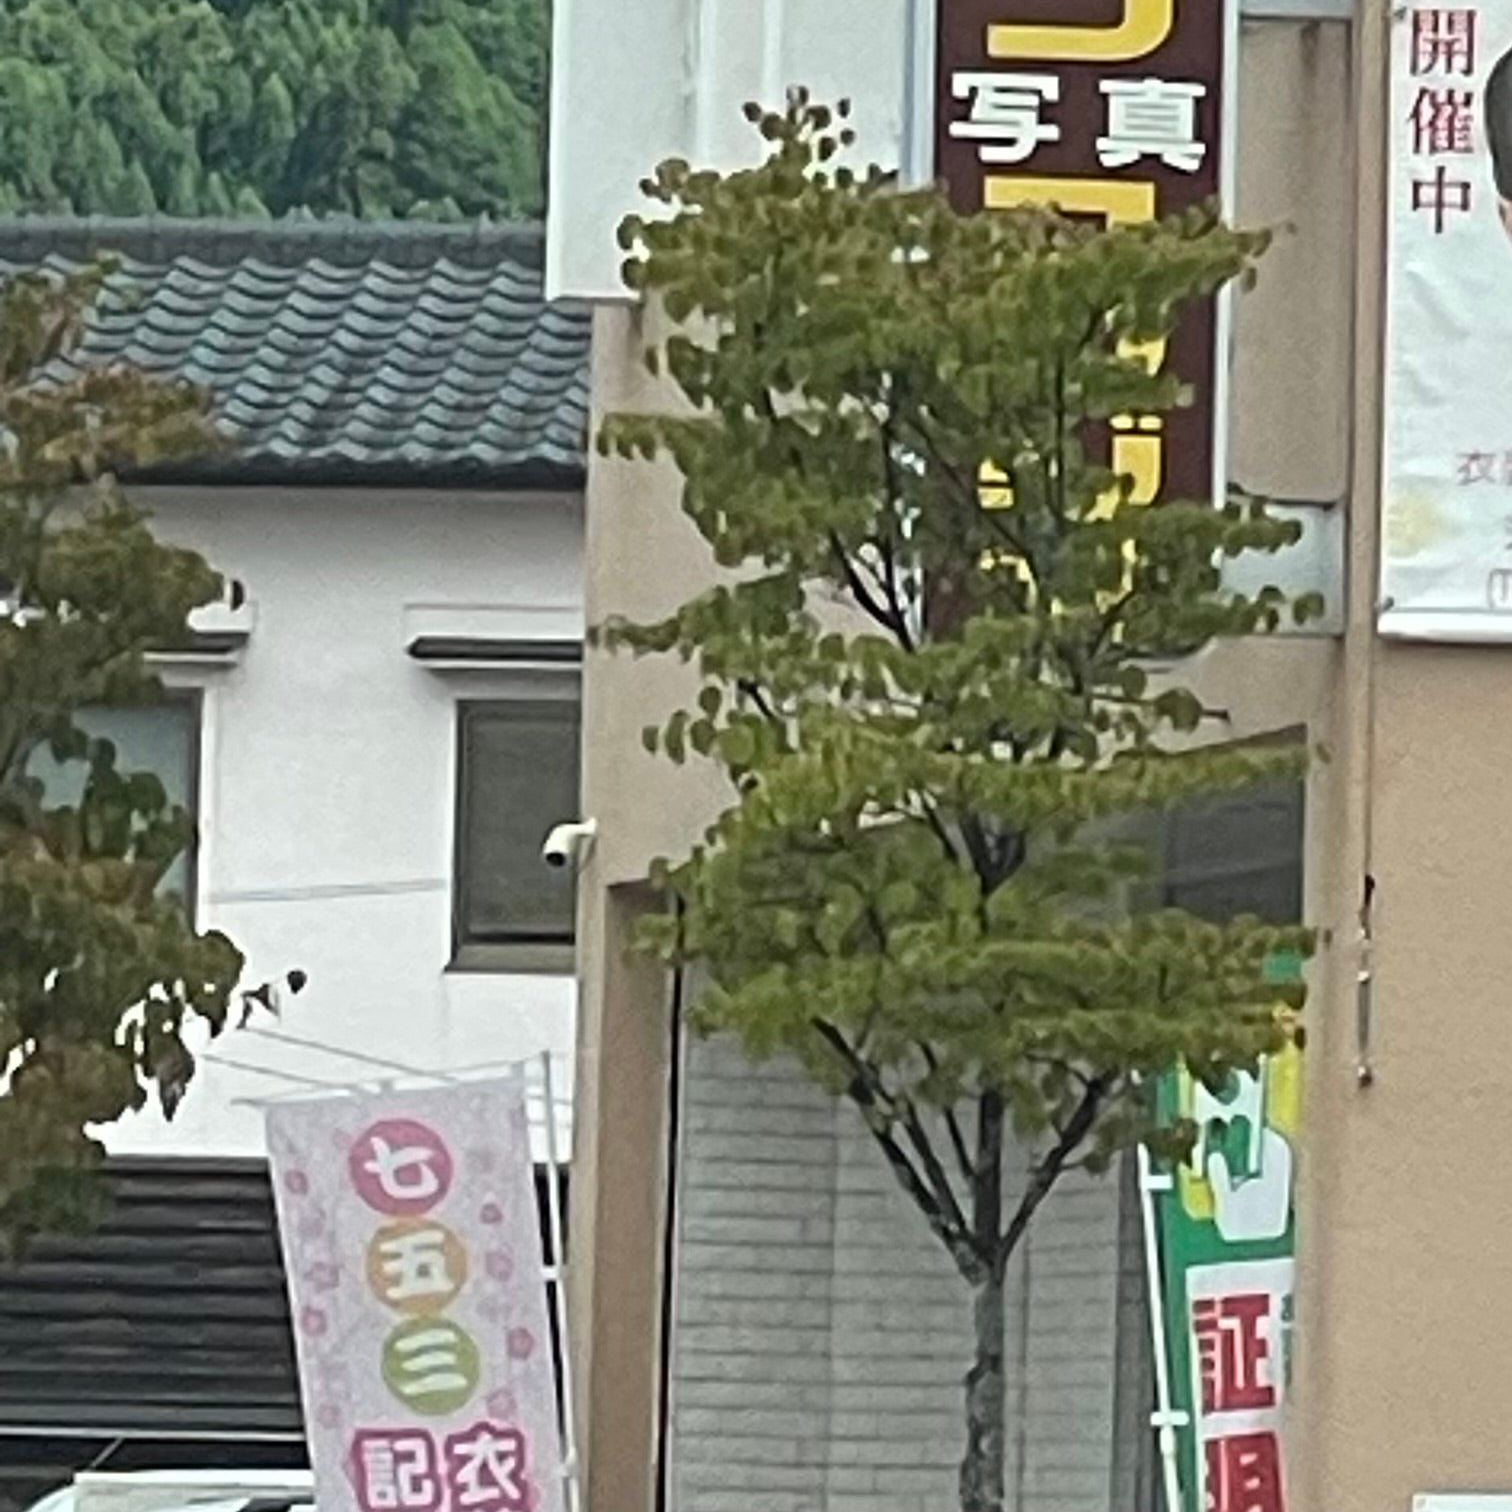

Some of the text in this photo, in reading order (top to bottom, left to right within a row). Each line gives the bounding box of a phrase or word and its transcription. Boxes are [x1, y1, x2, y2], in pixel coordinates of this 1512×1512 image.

[947, 72, 1206, 172] 写真
[364, 1135, 468, 1395] 七五三
